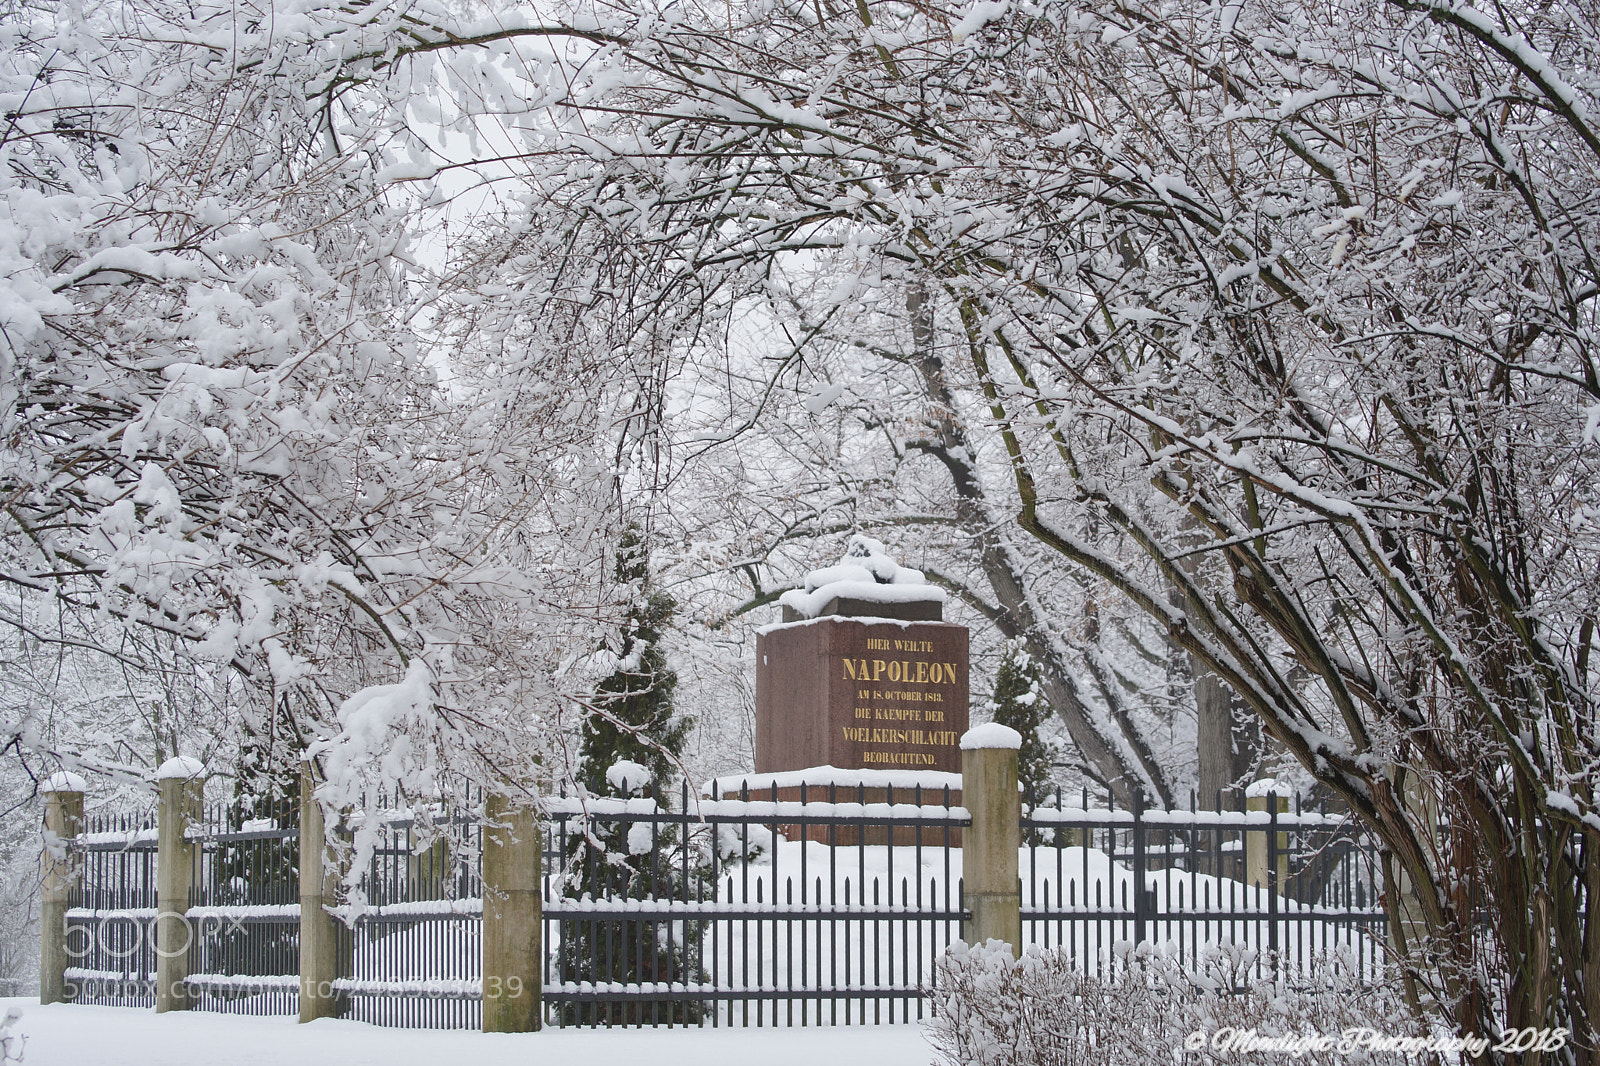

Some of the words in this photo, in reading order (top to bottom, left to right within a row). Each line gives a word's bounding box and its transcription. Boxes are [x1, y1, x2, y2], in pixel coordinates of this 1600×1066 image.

[867, 638, 890, 650] HIER
[894, 639, 934, 653] WEILTE
[842, 658, 958, 684] NAPOLEON
[857, 689, 870, 699] AM
[873, 690, 884, 700] 18.
[885, 691, 922, 701] OCTOBER
[924, 692, 944, 702] 1813.
[855, 707, 872, 719] DIE
[875, 708, 921, 721] KAEMPFE
[925, 710, 945, 722] DER
[842, 727, 958, 746] VOELKERSCHLACHT
[863, 751, 937, 765] BEOBACHTEND.
